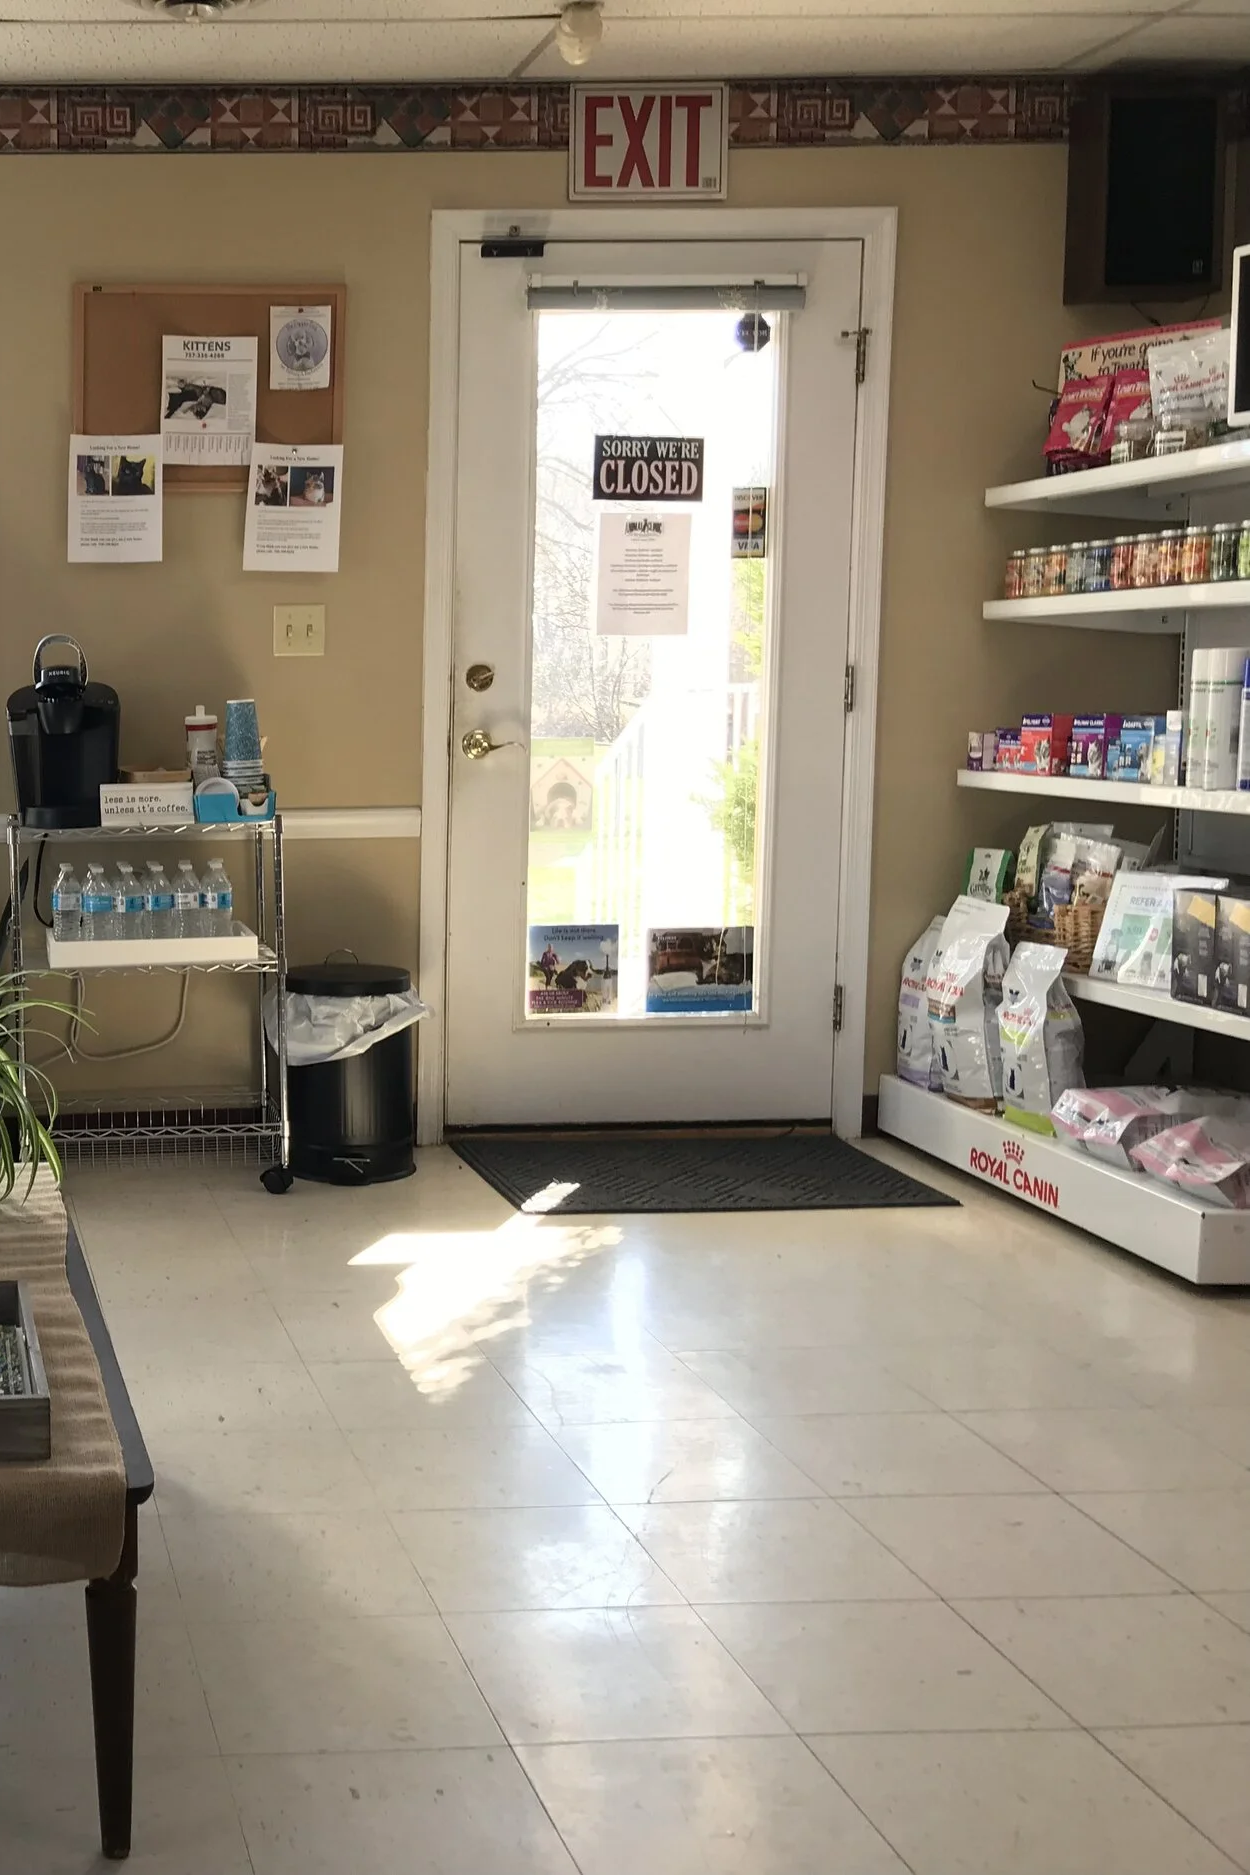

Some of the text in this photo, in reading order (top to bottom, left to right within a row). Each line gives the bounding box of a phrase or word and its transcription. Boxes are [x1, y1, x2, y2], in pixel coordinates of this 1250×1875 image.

[584, 95, 713, 187] EXIT
[183, 340, 231, 352] KITTENS
[1102, 344, 1136, 364] you're
[602, 440, 699, 459] SORRY WE'RE
[600, 460, 699, 494] CLOSED
[738, 541, 760, 550] VIA
[104, 796, 124, 804] less
[126, 795, 136, 803] is
[104, 804, 188, 814] unless it's coffee.
[970, 1147, 1059, 1209] ROYAL CANIN
